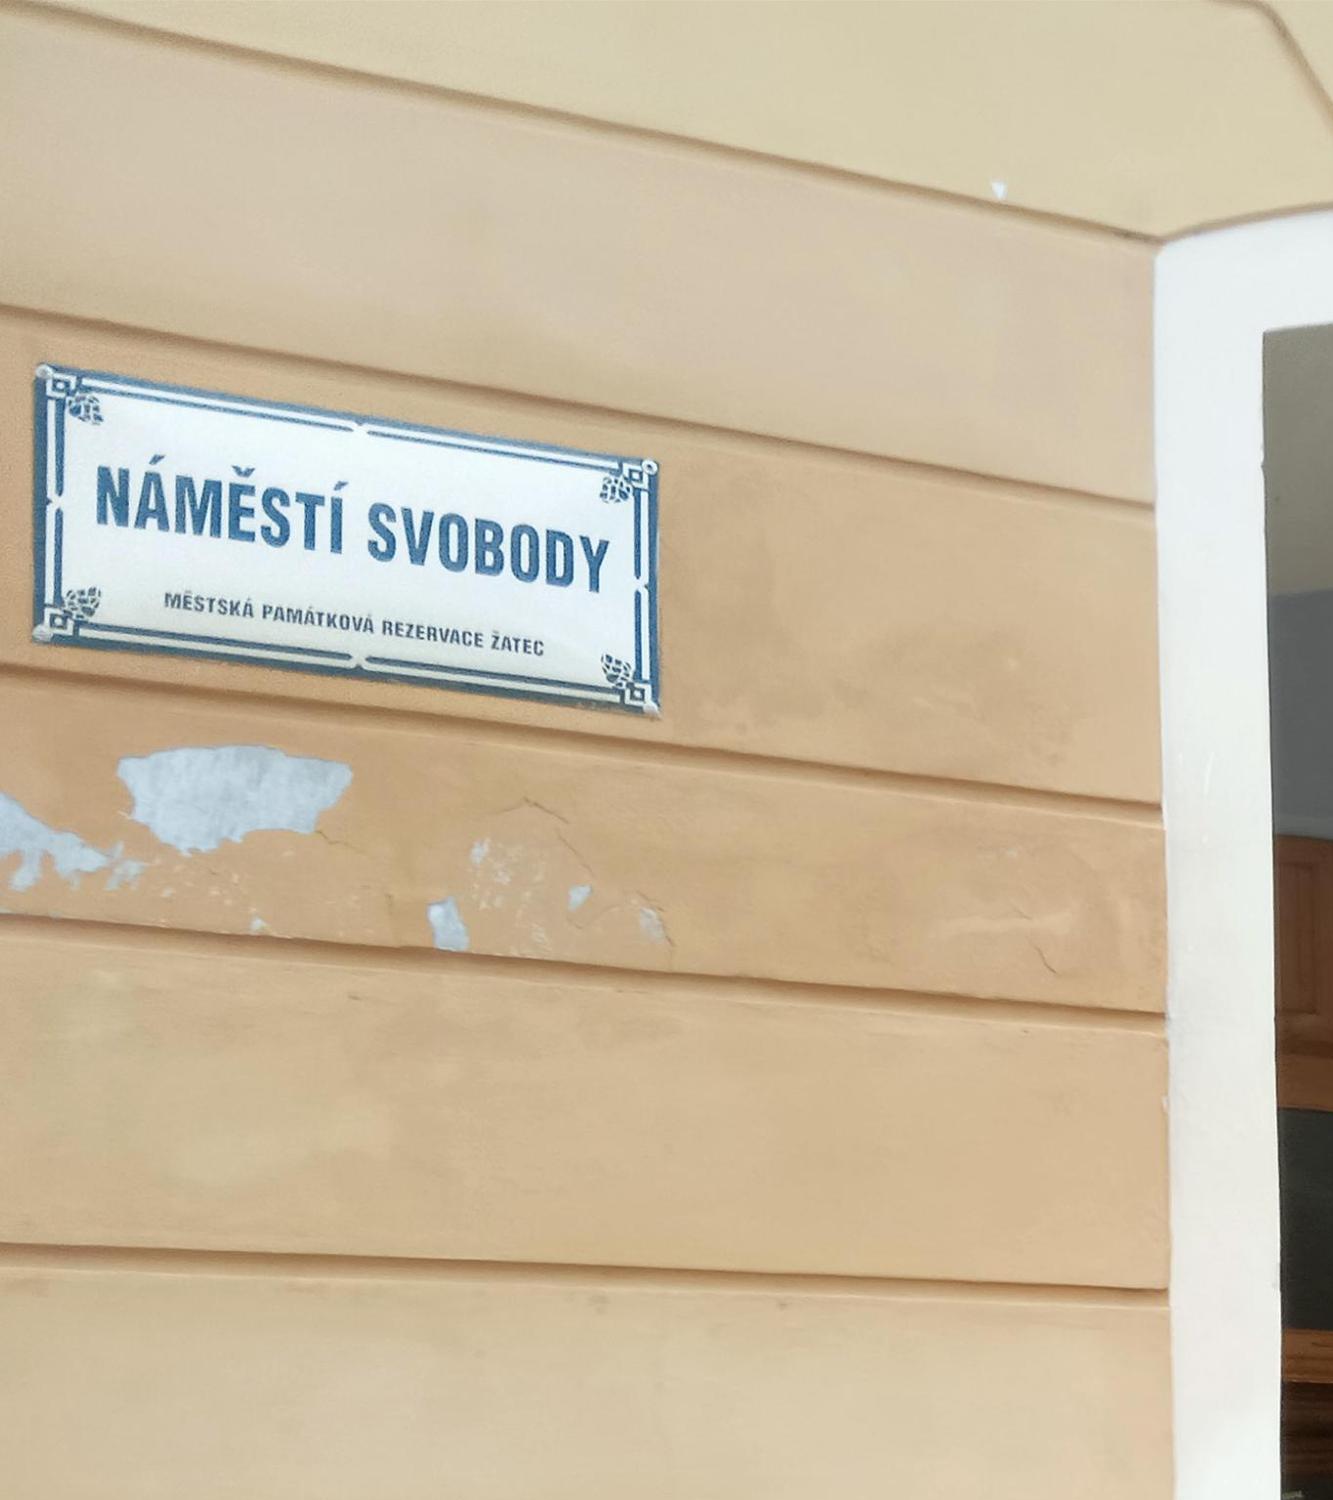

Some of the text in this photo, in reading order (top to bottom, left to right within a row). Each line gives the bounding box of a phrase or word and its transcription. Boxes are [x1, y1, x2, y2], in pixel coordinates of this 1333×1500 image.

[96, 454, 610, 593] NÁMĚSTÍ SVOBODY
[164, 590, 545, 656] MĚSTSKÁ PAMÁTKOVÁ REZERVACE ŽATEC
